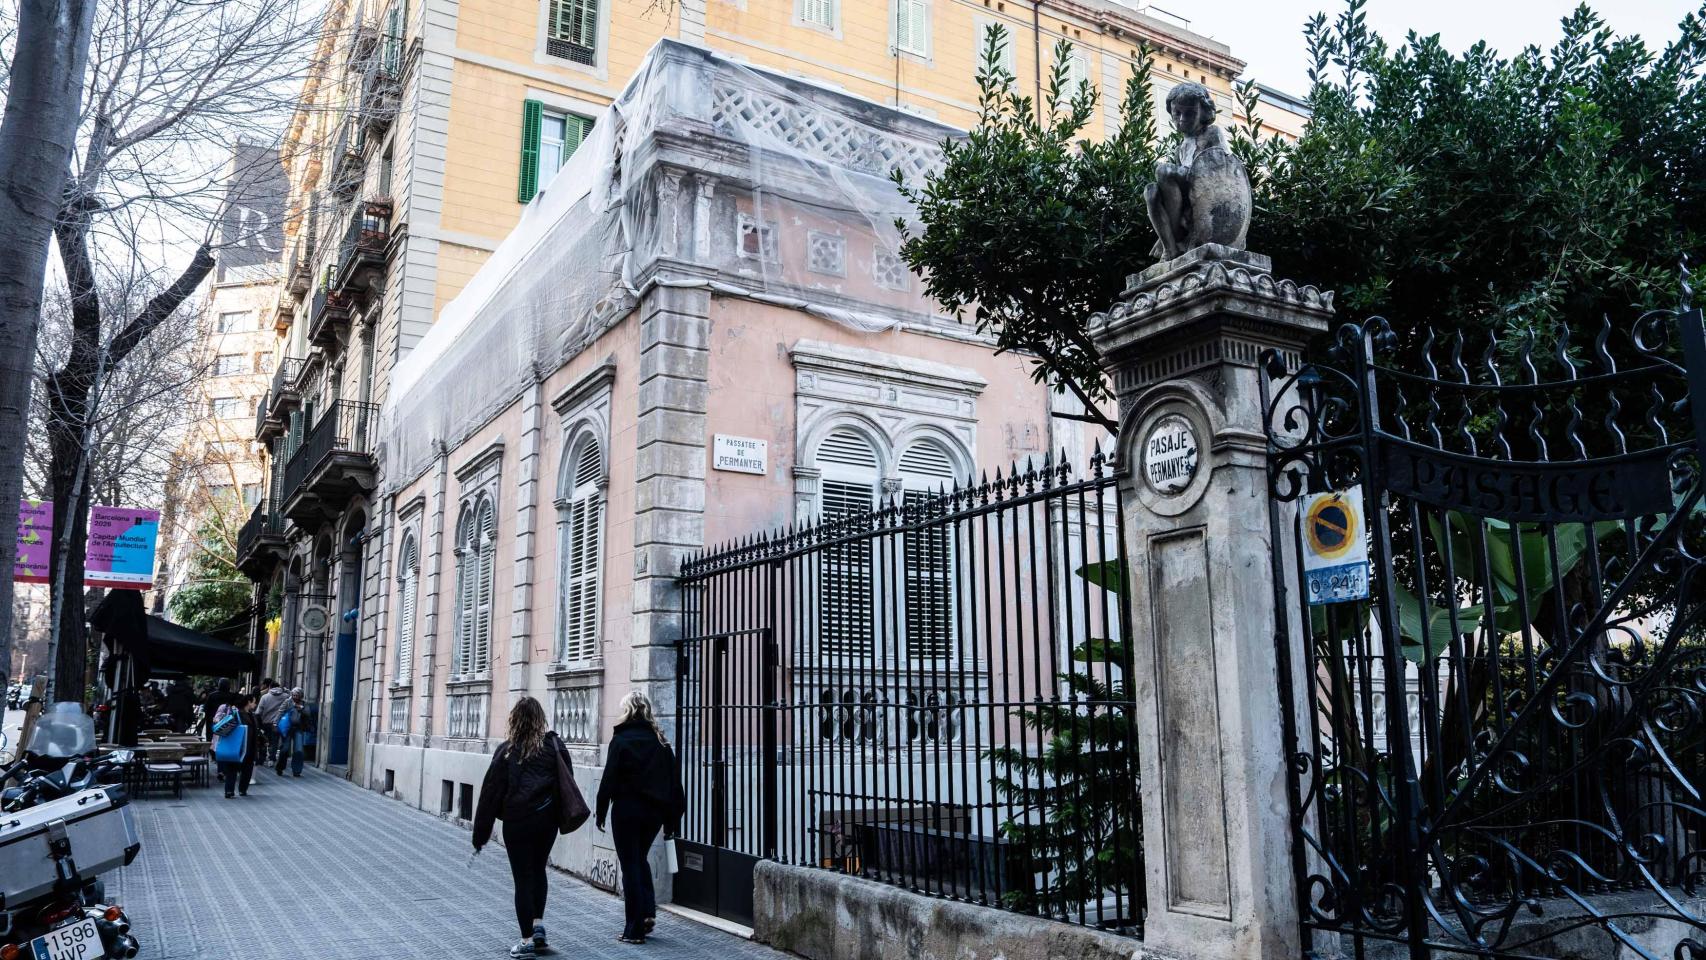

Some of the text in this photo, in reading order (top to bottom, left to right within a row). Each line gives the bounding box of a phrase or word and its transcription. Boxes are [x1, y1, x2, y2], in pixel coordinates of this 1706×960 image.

[1150, 431, 1188, 457] PASAJE
[719, 456, 762, 469] PERMANYER
[95, 513, 130, 521] Barcelona
[119, 534, 146, 542] Mundial
[52, 923, 94, 951] 1596
